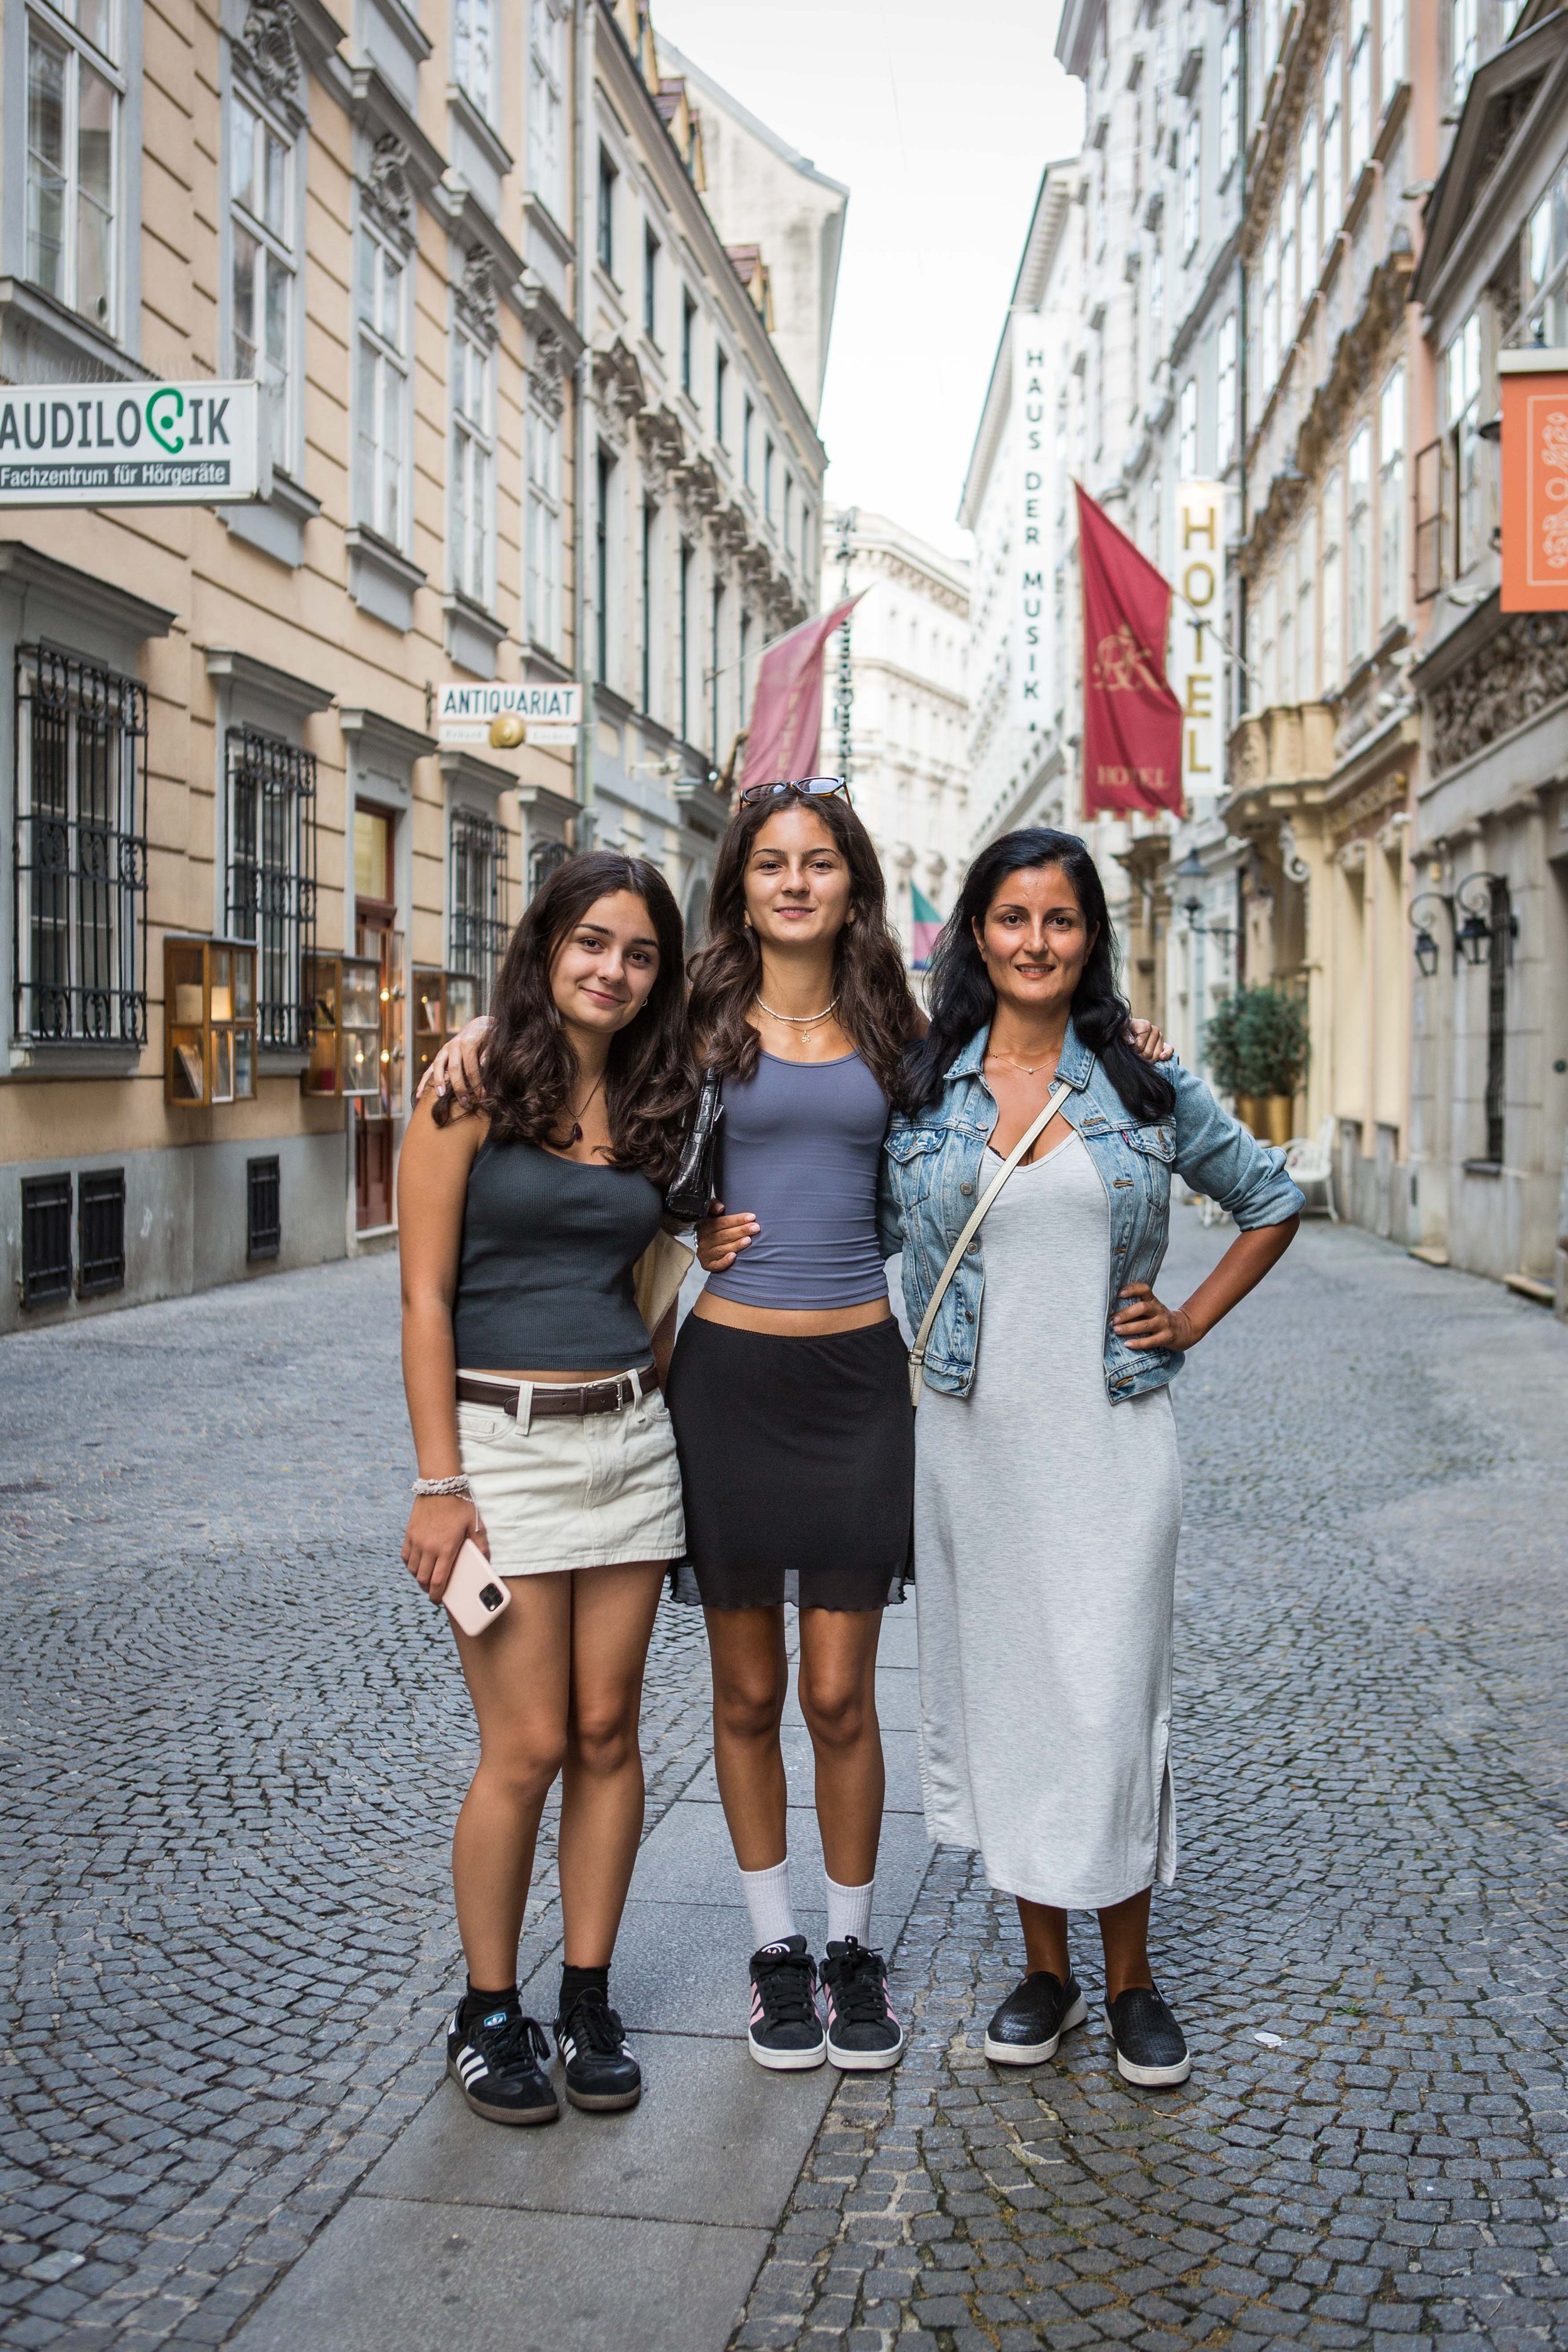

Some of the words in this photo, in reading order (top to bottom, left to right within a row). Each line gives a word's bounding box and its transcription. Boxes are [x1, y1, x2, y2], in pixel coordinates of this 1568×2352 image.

[1026, 349, 1044, 450] HAUS
[1, 467, 108, 487] Fachzentrum
[114, 464, 136, 485] für
[143, 463, 225, 487] Hörgeräte
[1025, 472, 1042, 546] DER
[1023, 571, 1043, 699] MUSIK
[1182, 506, 1215, 774] HOTEL
[443, 689, 574, 715] ANTIQUARIAT
[1097, 765, 1170, 788] HOEL
